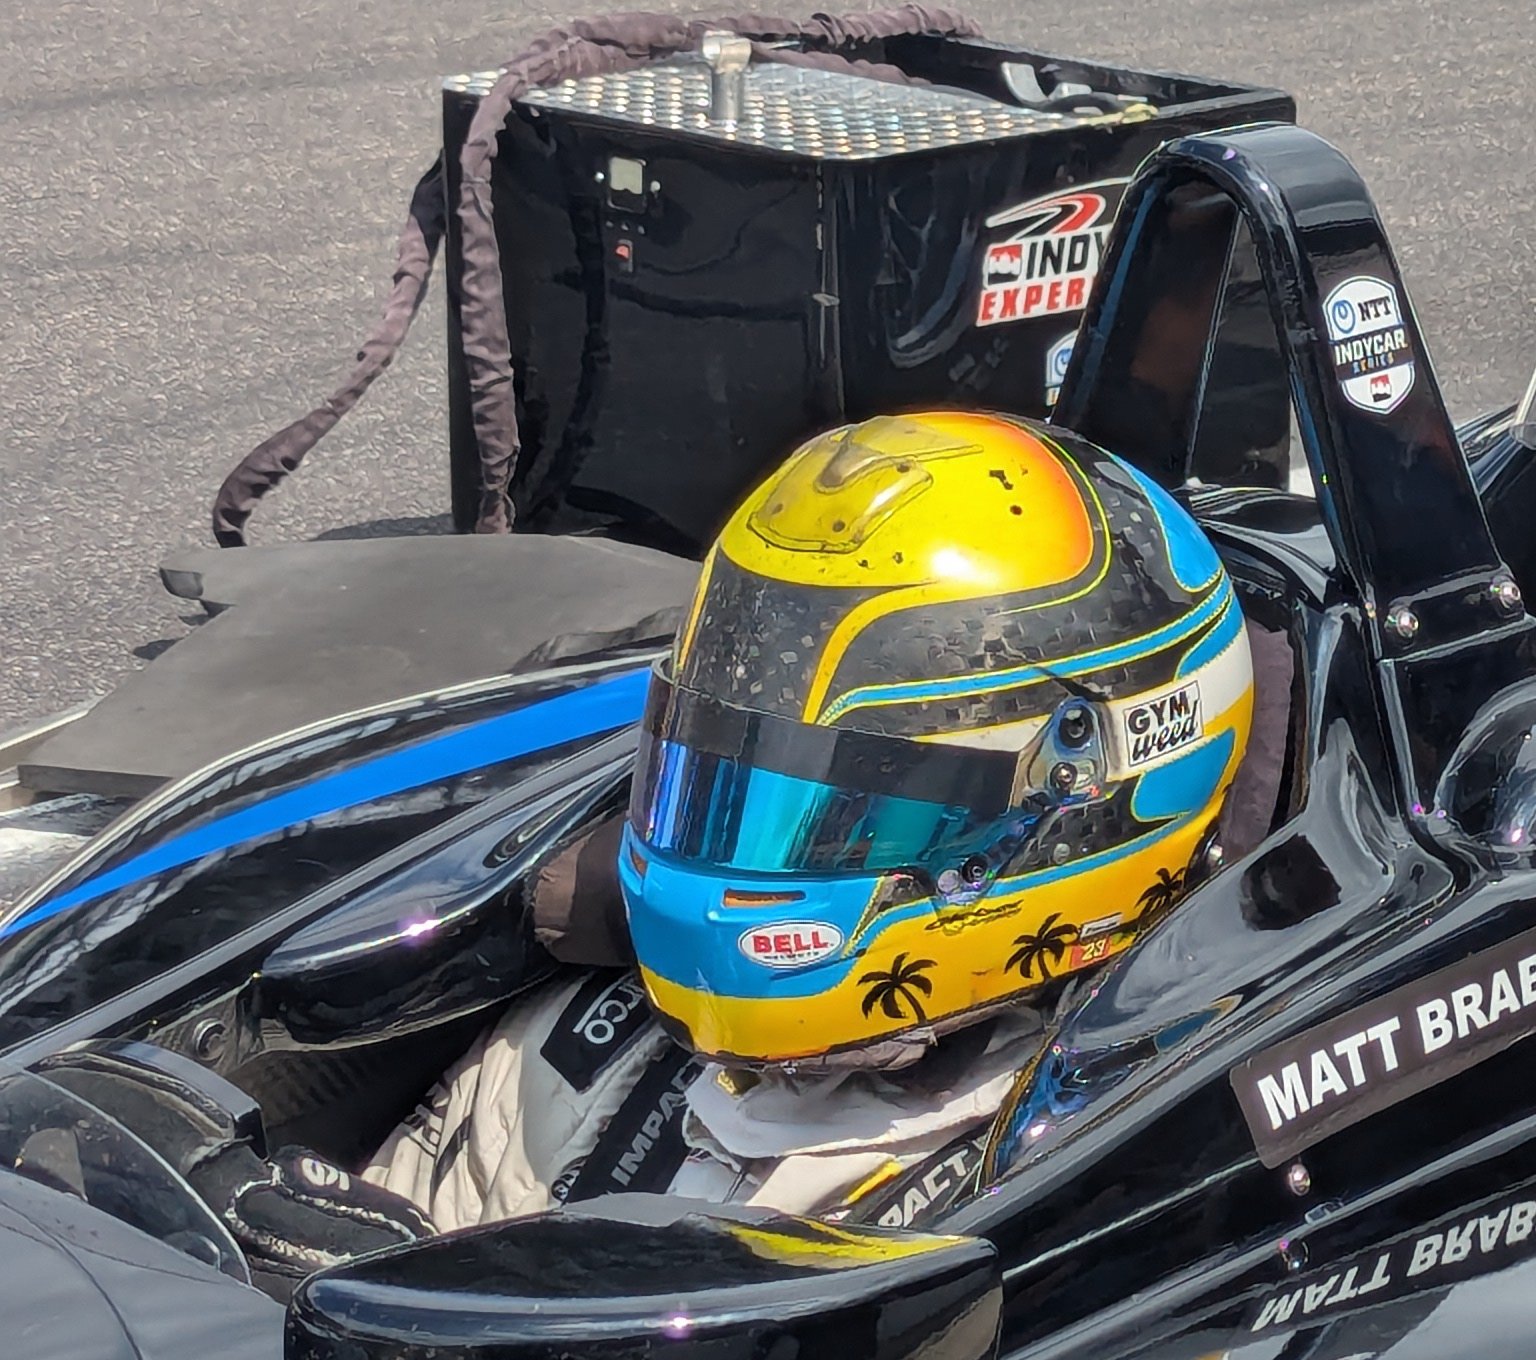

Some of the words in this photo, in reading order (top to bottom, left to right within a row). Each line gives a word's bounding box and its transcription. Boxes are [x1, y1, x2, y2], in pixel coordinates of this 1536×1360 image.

[1357, 296, 1391, 321] NTT
[1334, 328, 1406, 366] INDYCAR
[1128, 691, 1190, 734] GYM
[753, 931, 829, 953] BELL
[1257, 1016, 1401, 1131] MATT
